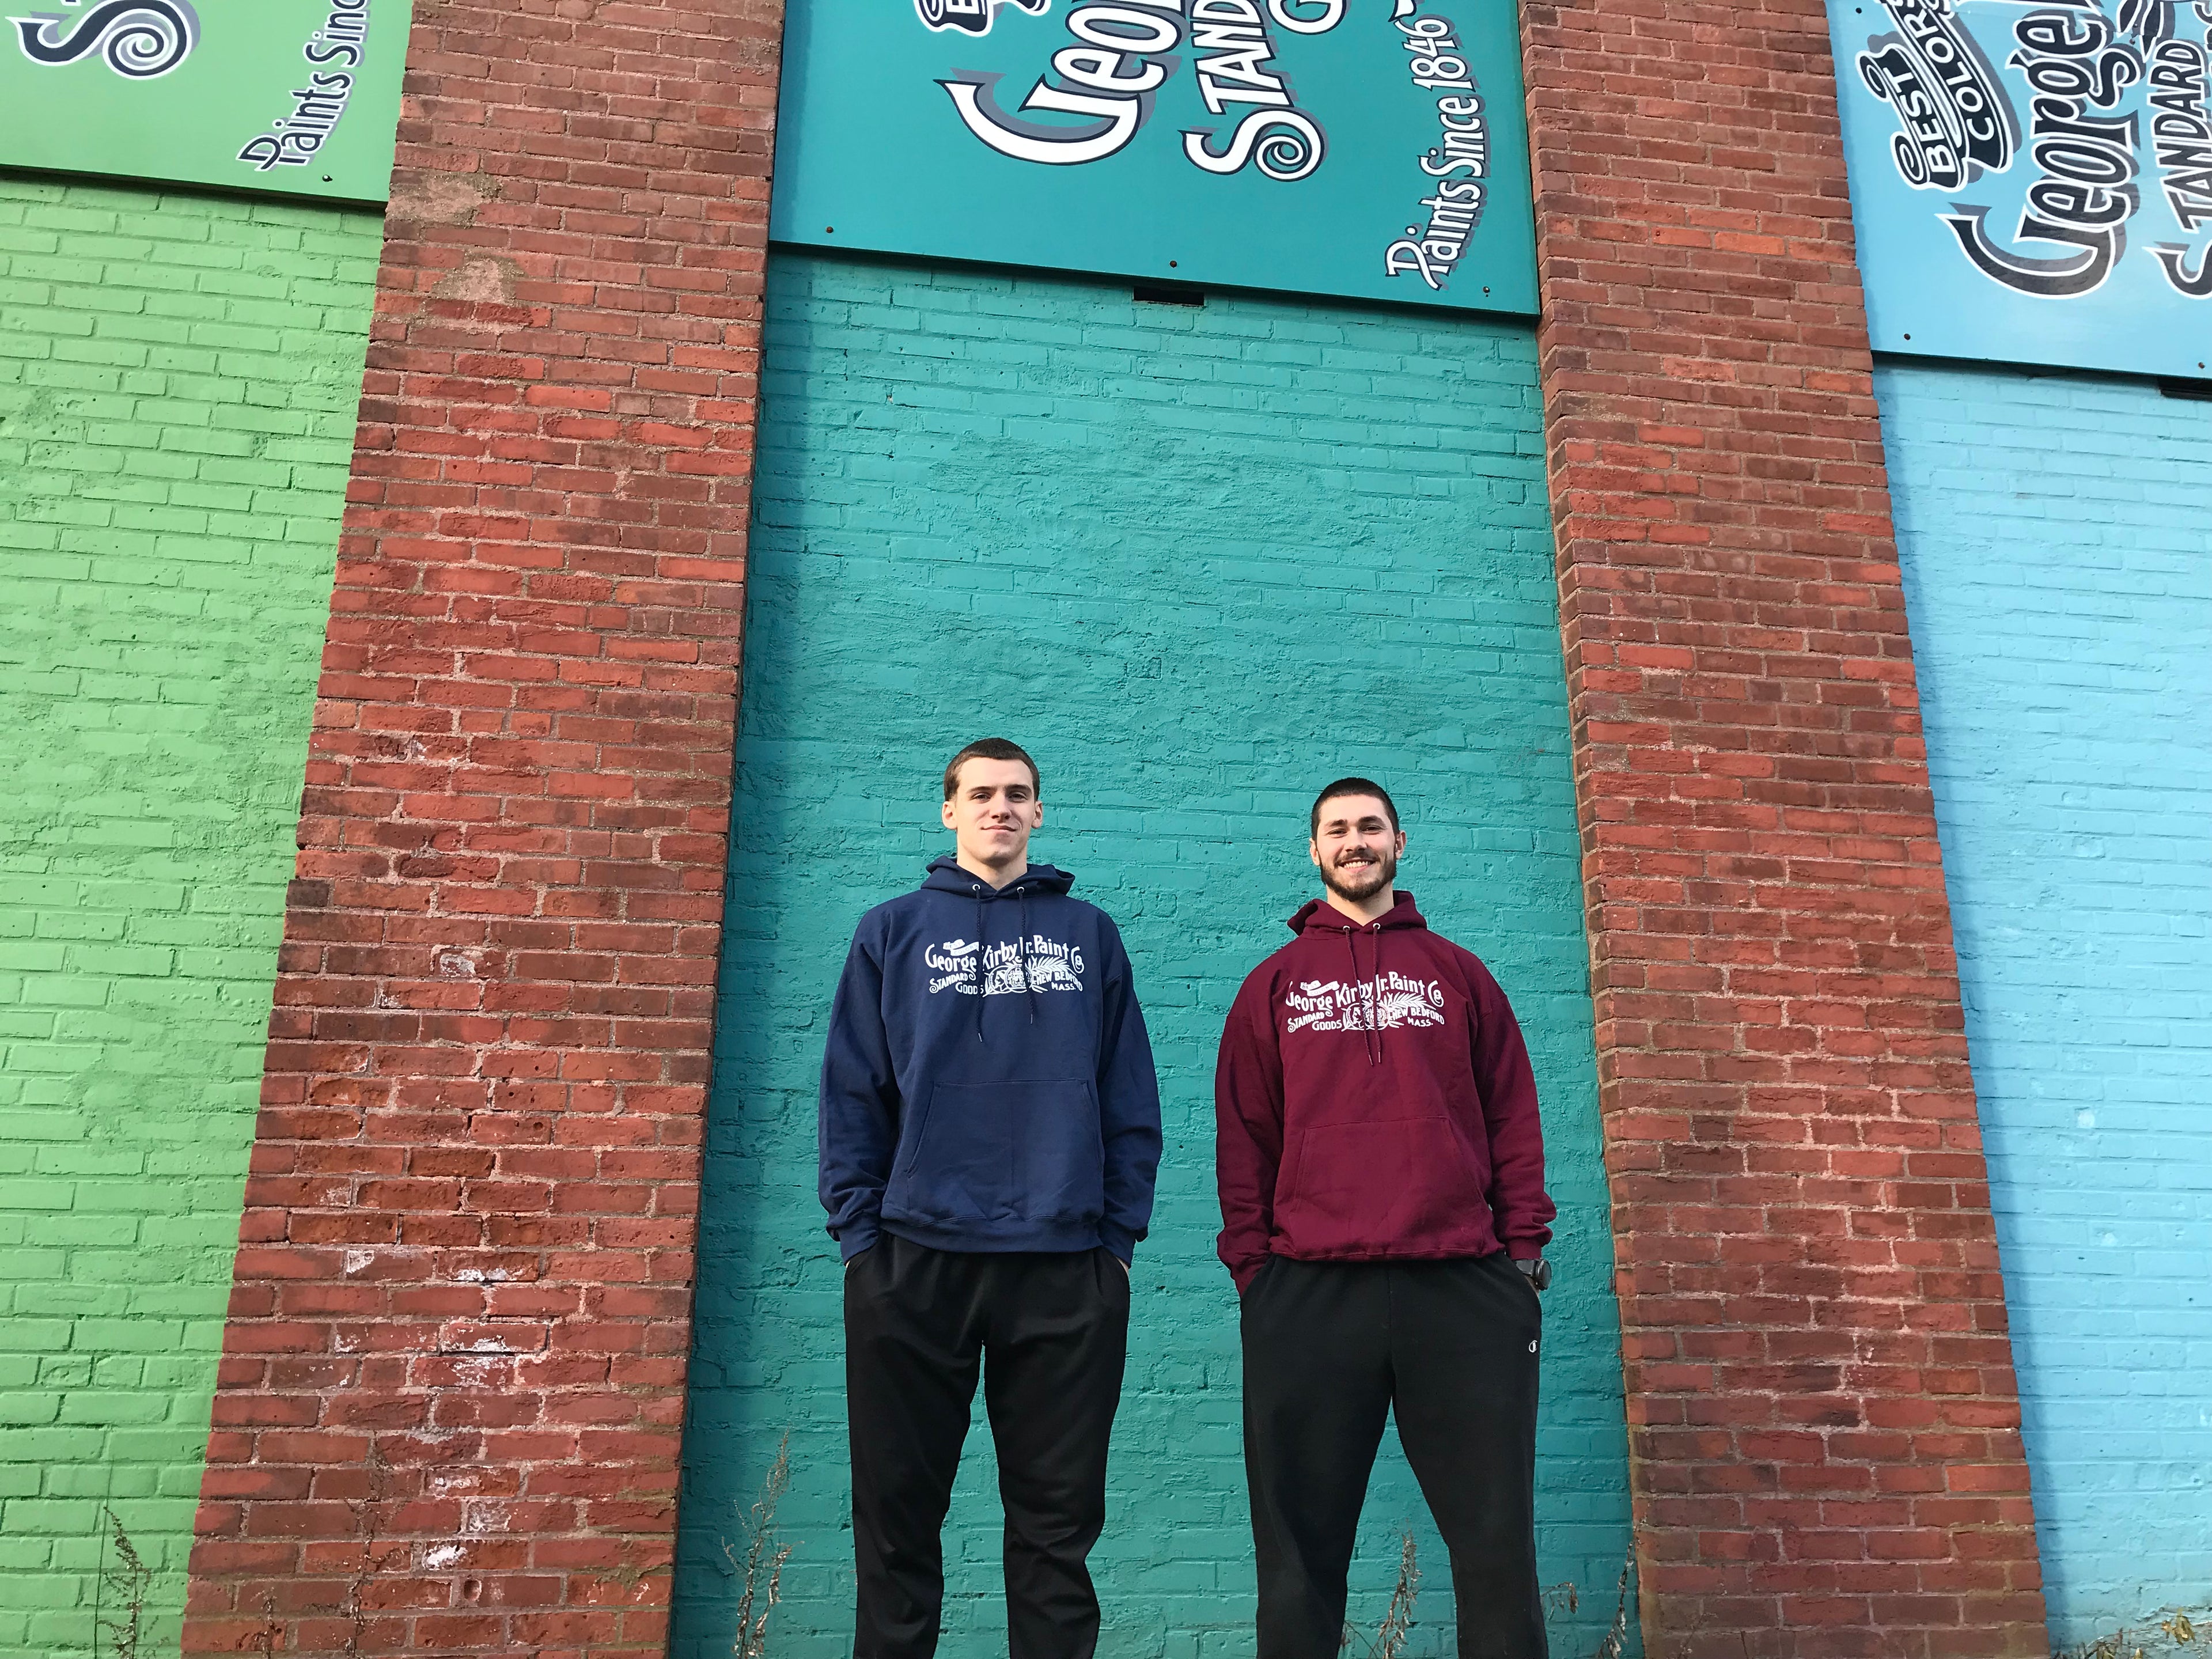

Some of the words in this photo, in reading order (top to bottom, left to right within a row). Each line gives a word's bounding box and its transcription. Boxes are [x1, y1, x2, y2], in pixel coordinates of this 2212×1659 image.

[933, 0, 1185, 166] Geo
[1393, 18, 1476, 92] 1846
[236, 71, 353, 172] Paints
[1417, 96, 1486, 179] Since
[1883, 67, 1956, 172] BEST
[1934, 15, 2141, 299] George
[1385, 180, 1482, 291] Paints
[925, 944, 977, 980] George
[1033, 935, 1069, 960] Paint
[929, 972, 968, 994] STANDARD
[1285, 980, 1334, 1017] George
[1335, 979, 1373, 1008] Kirby
[1388, 971, 1425, 996] Paint
[1287, 1012, 1325, 1033] STANDARD
[1312, 1019, 1342, 1031] GOODS
[1410, 1006, 1445, 1025] BEDFORD
